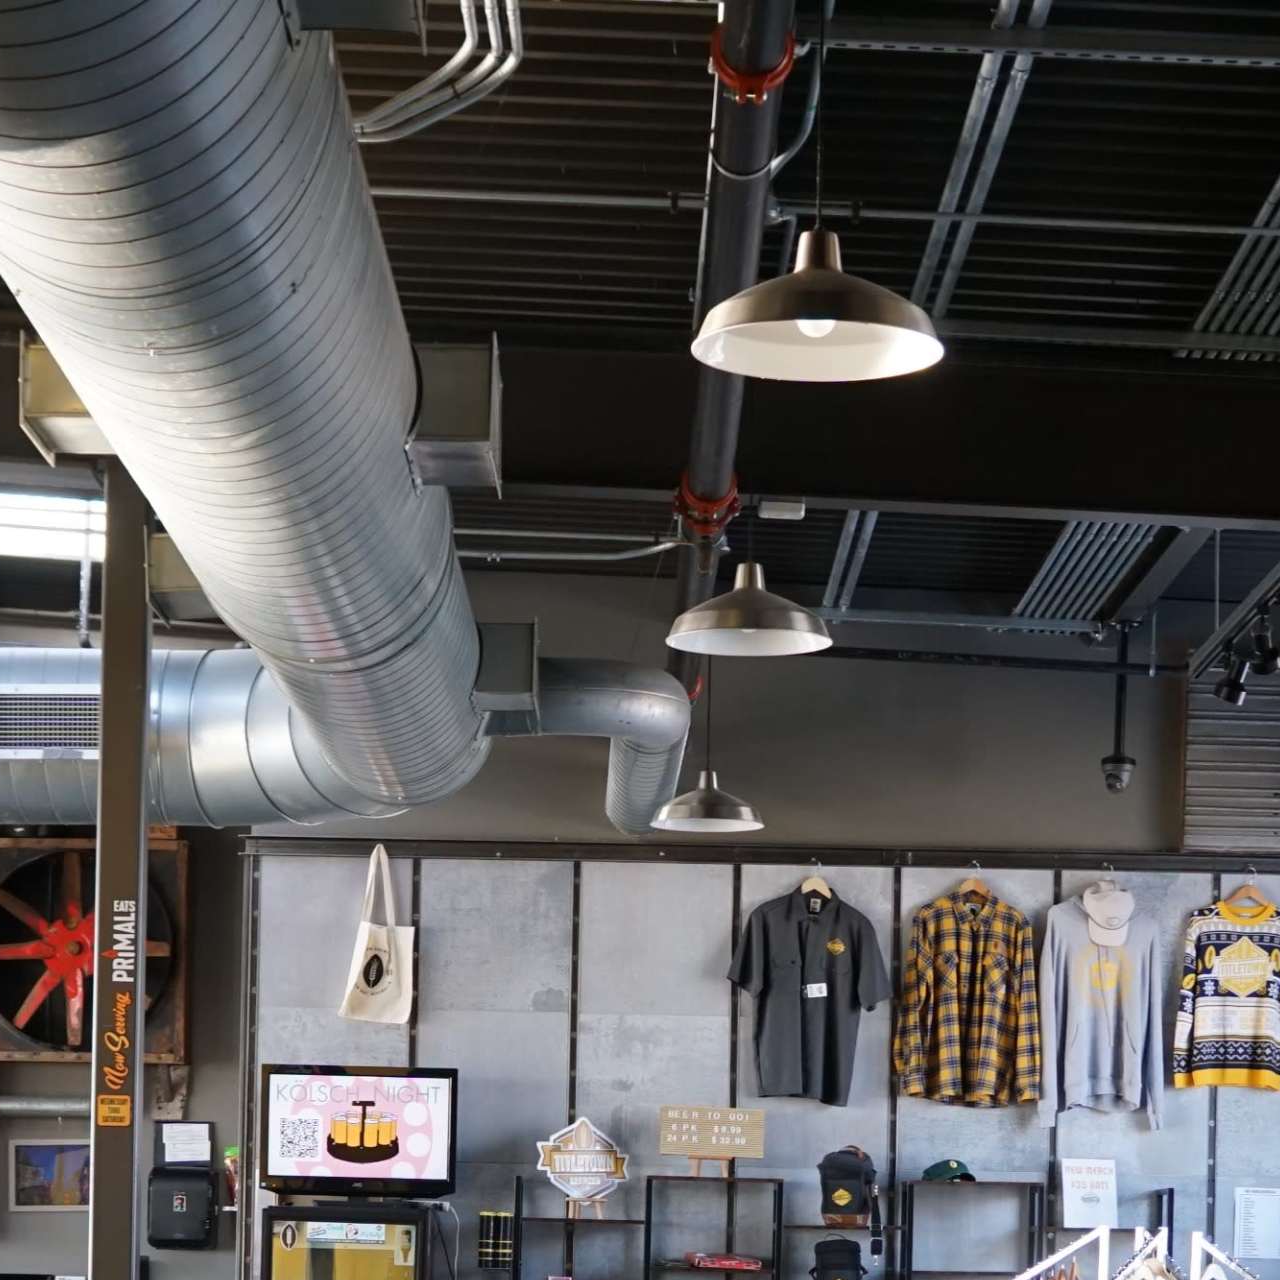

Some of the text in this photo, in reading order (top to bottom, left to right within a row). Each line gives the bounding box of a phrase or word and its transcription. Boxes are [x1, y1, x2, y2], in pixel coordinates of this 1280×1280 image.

[113, 900, 136, 912] EATS
[103, 991, 133, 1090] Now Serving
[276, 1080, 441, 1105] KÖLSCH NIGHT
